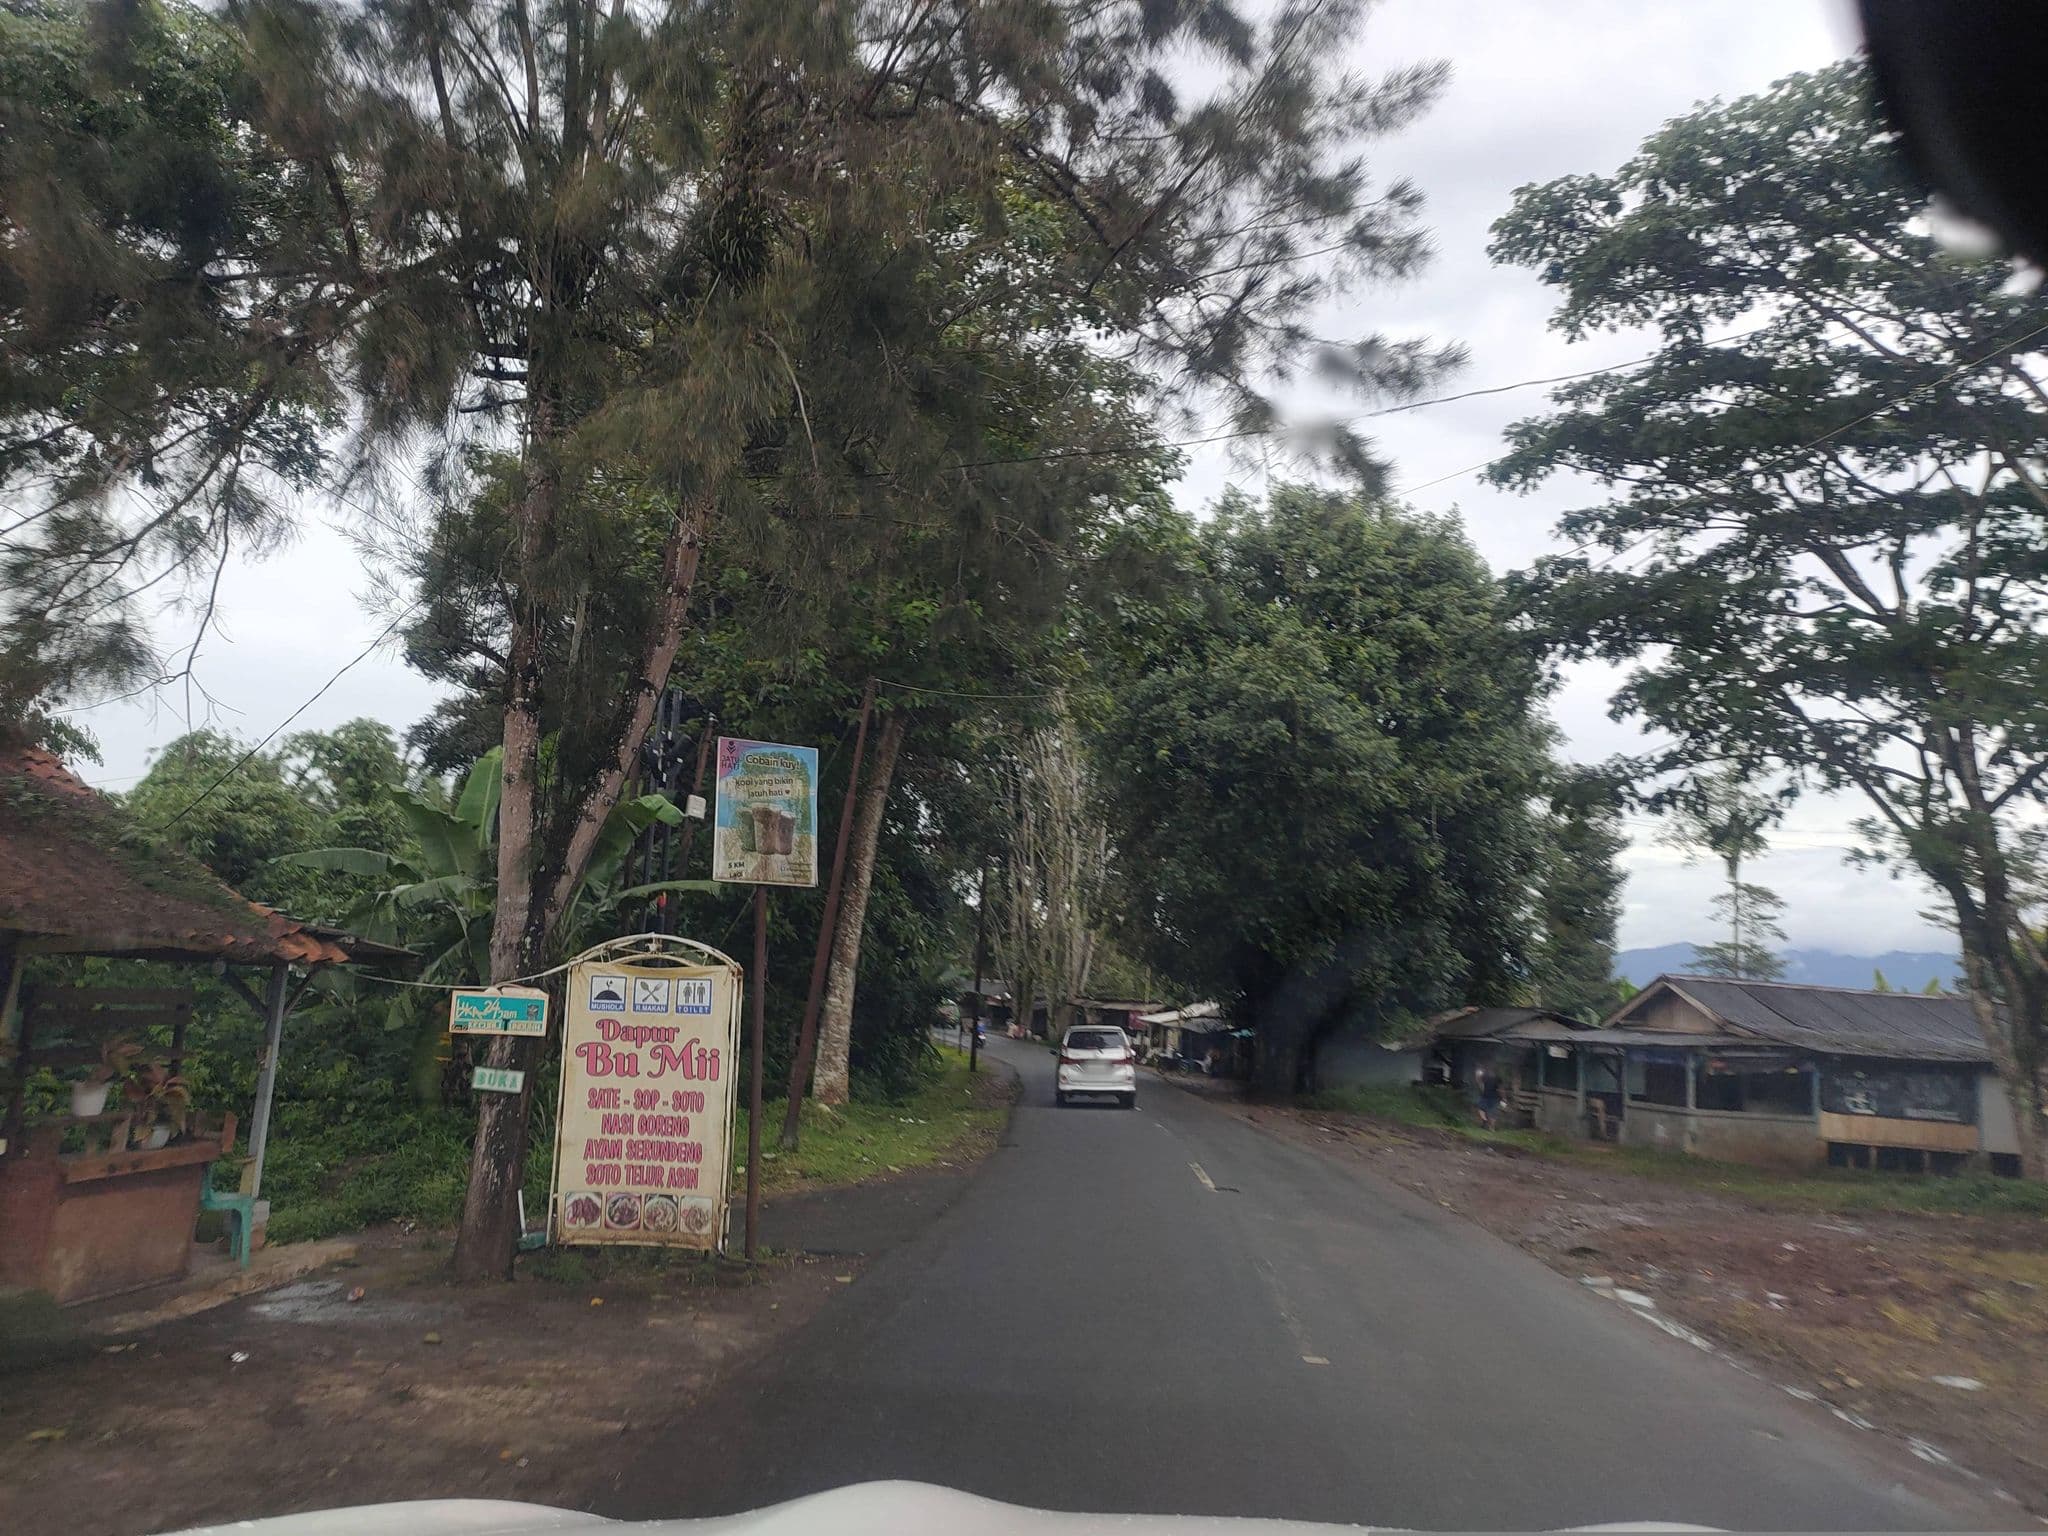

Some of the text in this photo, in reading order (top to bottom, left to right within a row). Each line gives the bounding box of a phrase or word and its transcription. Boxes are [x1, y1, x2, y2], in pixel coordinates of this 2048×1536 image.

[745, 754, 778, 768] Cobain
[774, 776, 794, 785] bikin
[591, 1003, 625, 1011] MUSHOLA
[677, 1006, 711, 1014] TOILET
[595, 1018, 680, 1049] Dapur
[575, 1037, 720, 1081] Bu Mii
[587, 1087, 621, 1110] SATE
[633, 1088, 660, 1111] SOP
[672, 1090, 705, 1113] SOTO
[601, 1113, 690, 1137] NASI GORENG
[583, 1138, 703, 1165] AYAM SERUNDENG
[585, 1164, 699, 1190] SOTO TELUR ASIN
